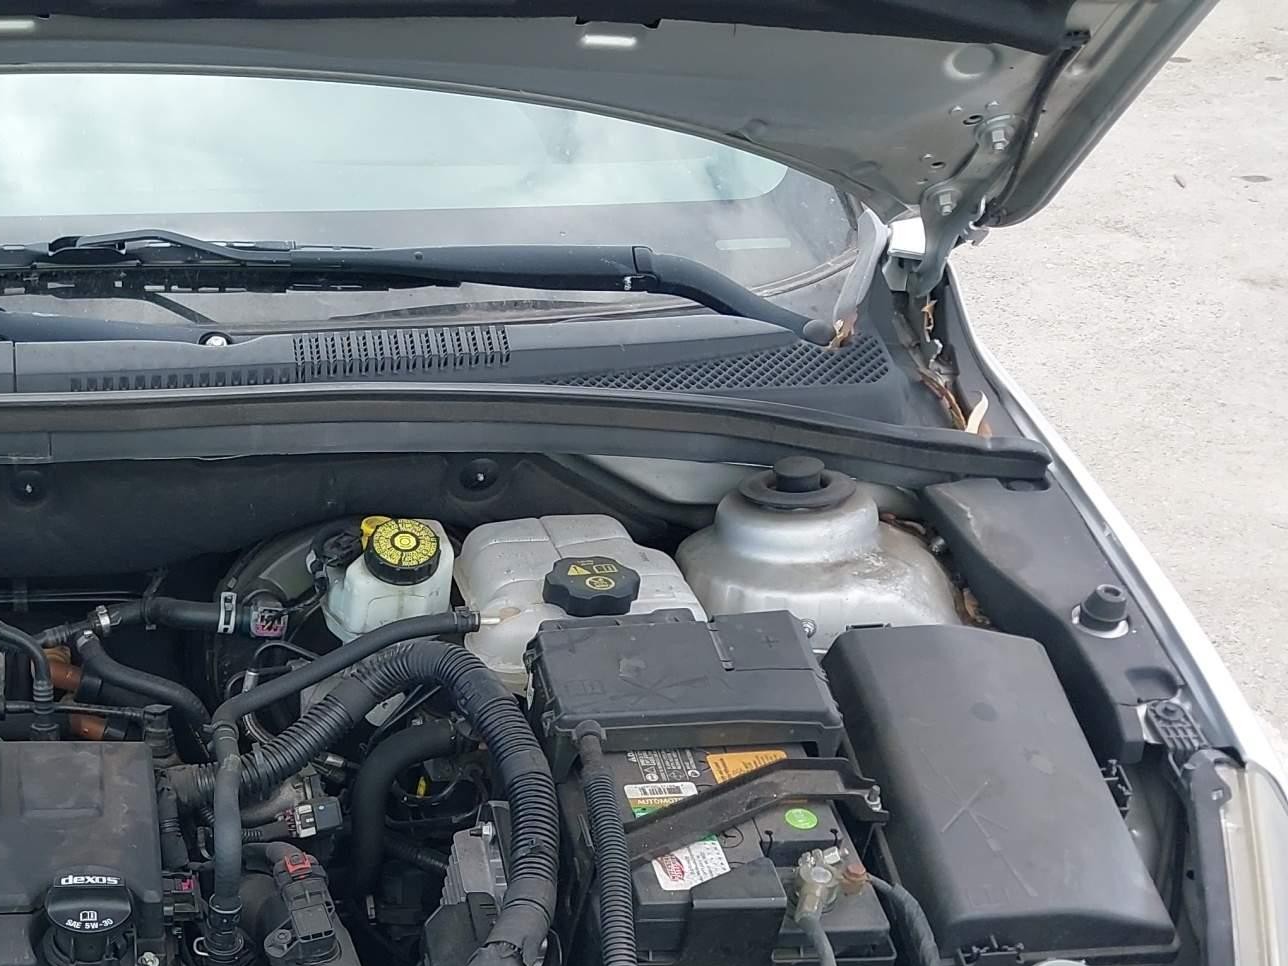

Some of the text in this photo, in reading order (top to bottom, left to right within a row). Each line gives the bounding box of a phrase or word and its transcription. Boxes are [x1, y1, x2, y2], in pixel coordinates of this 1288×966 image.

[60, 874, 121, 885] dexos
[65, 918, 114, 930] SAE 5W-30
